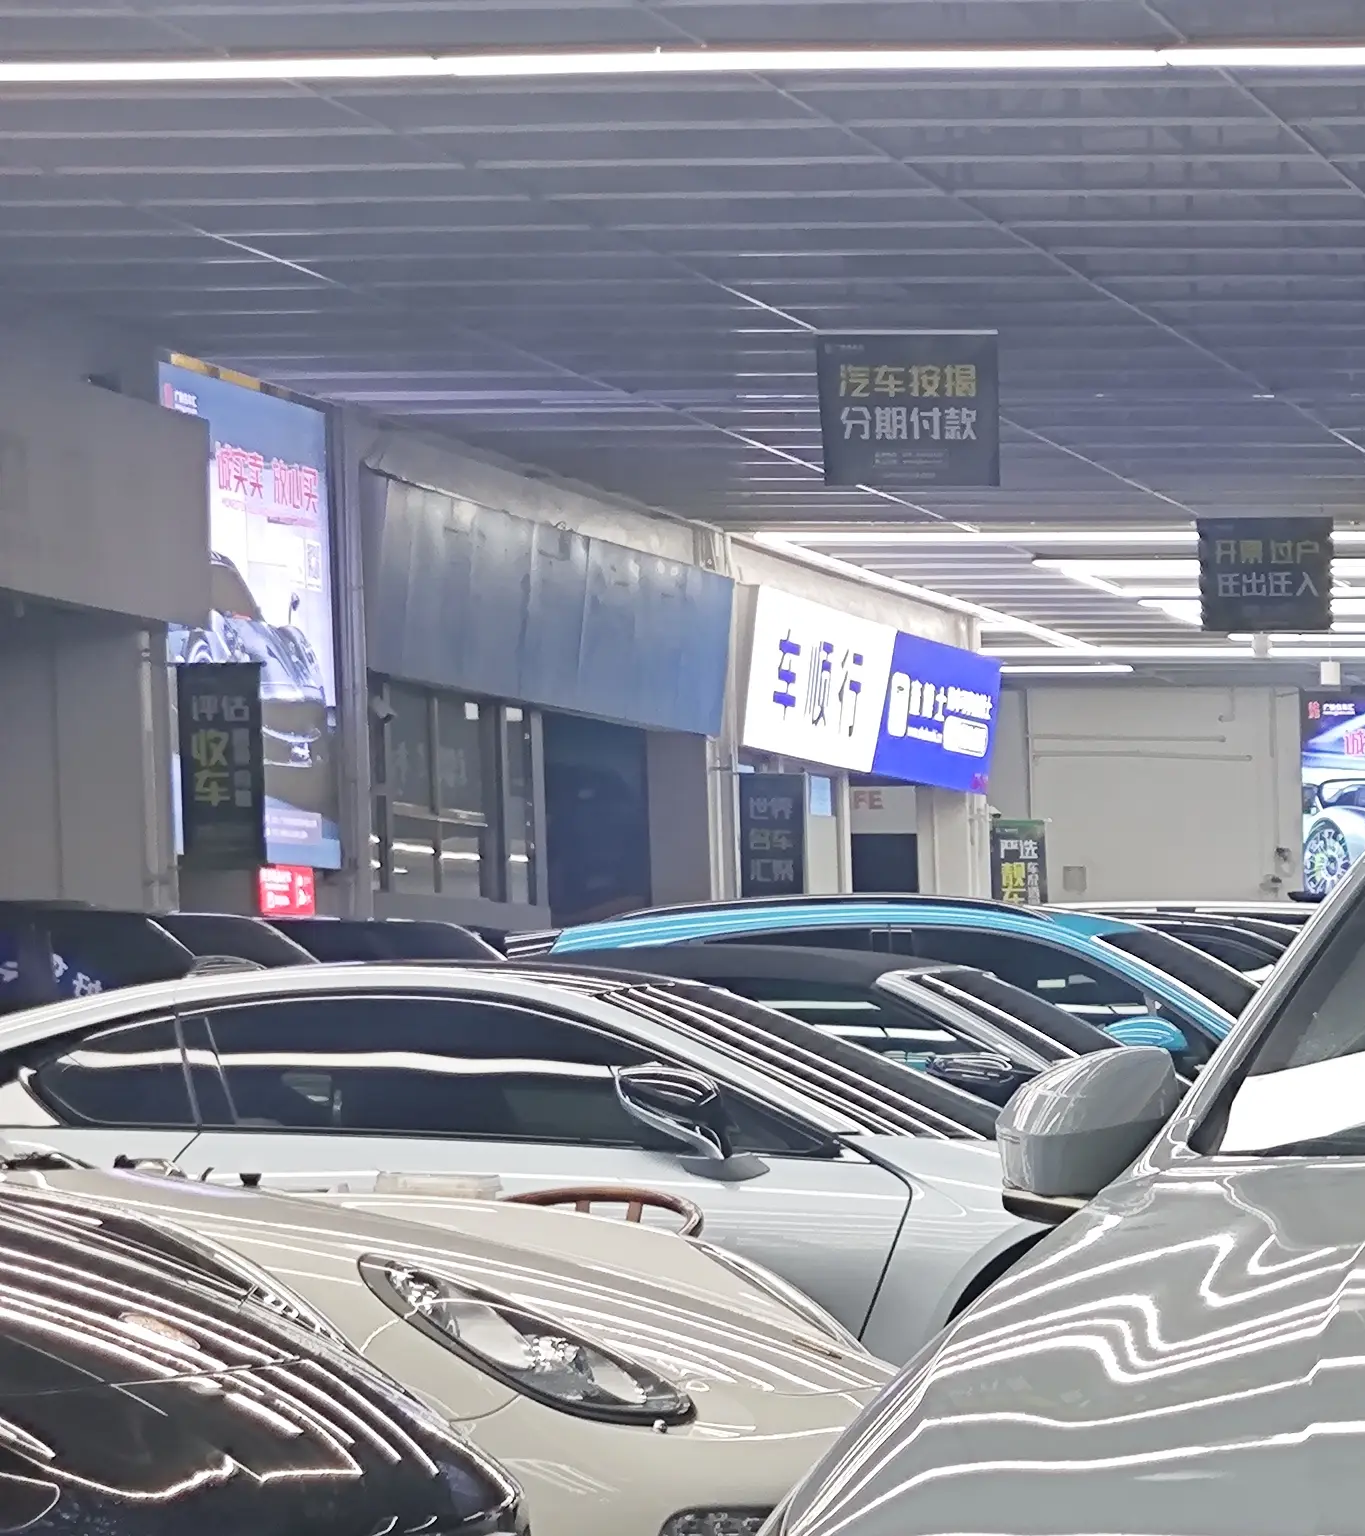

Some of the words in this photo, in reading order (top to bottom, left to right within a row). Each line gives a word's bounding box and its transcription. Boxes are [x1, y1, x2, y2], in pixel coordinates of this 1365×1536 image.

[839, 364, 976, 397] 汽车按揭
[840, 406, 977, 440] 分期付款
[1000, 839, 1038, 859] 严选
